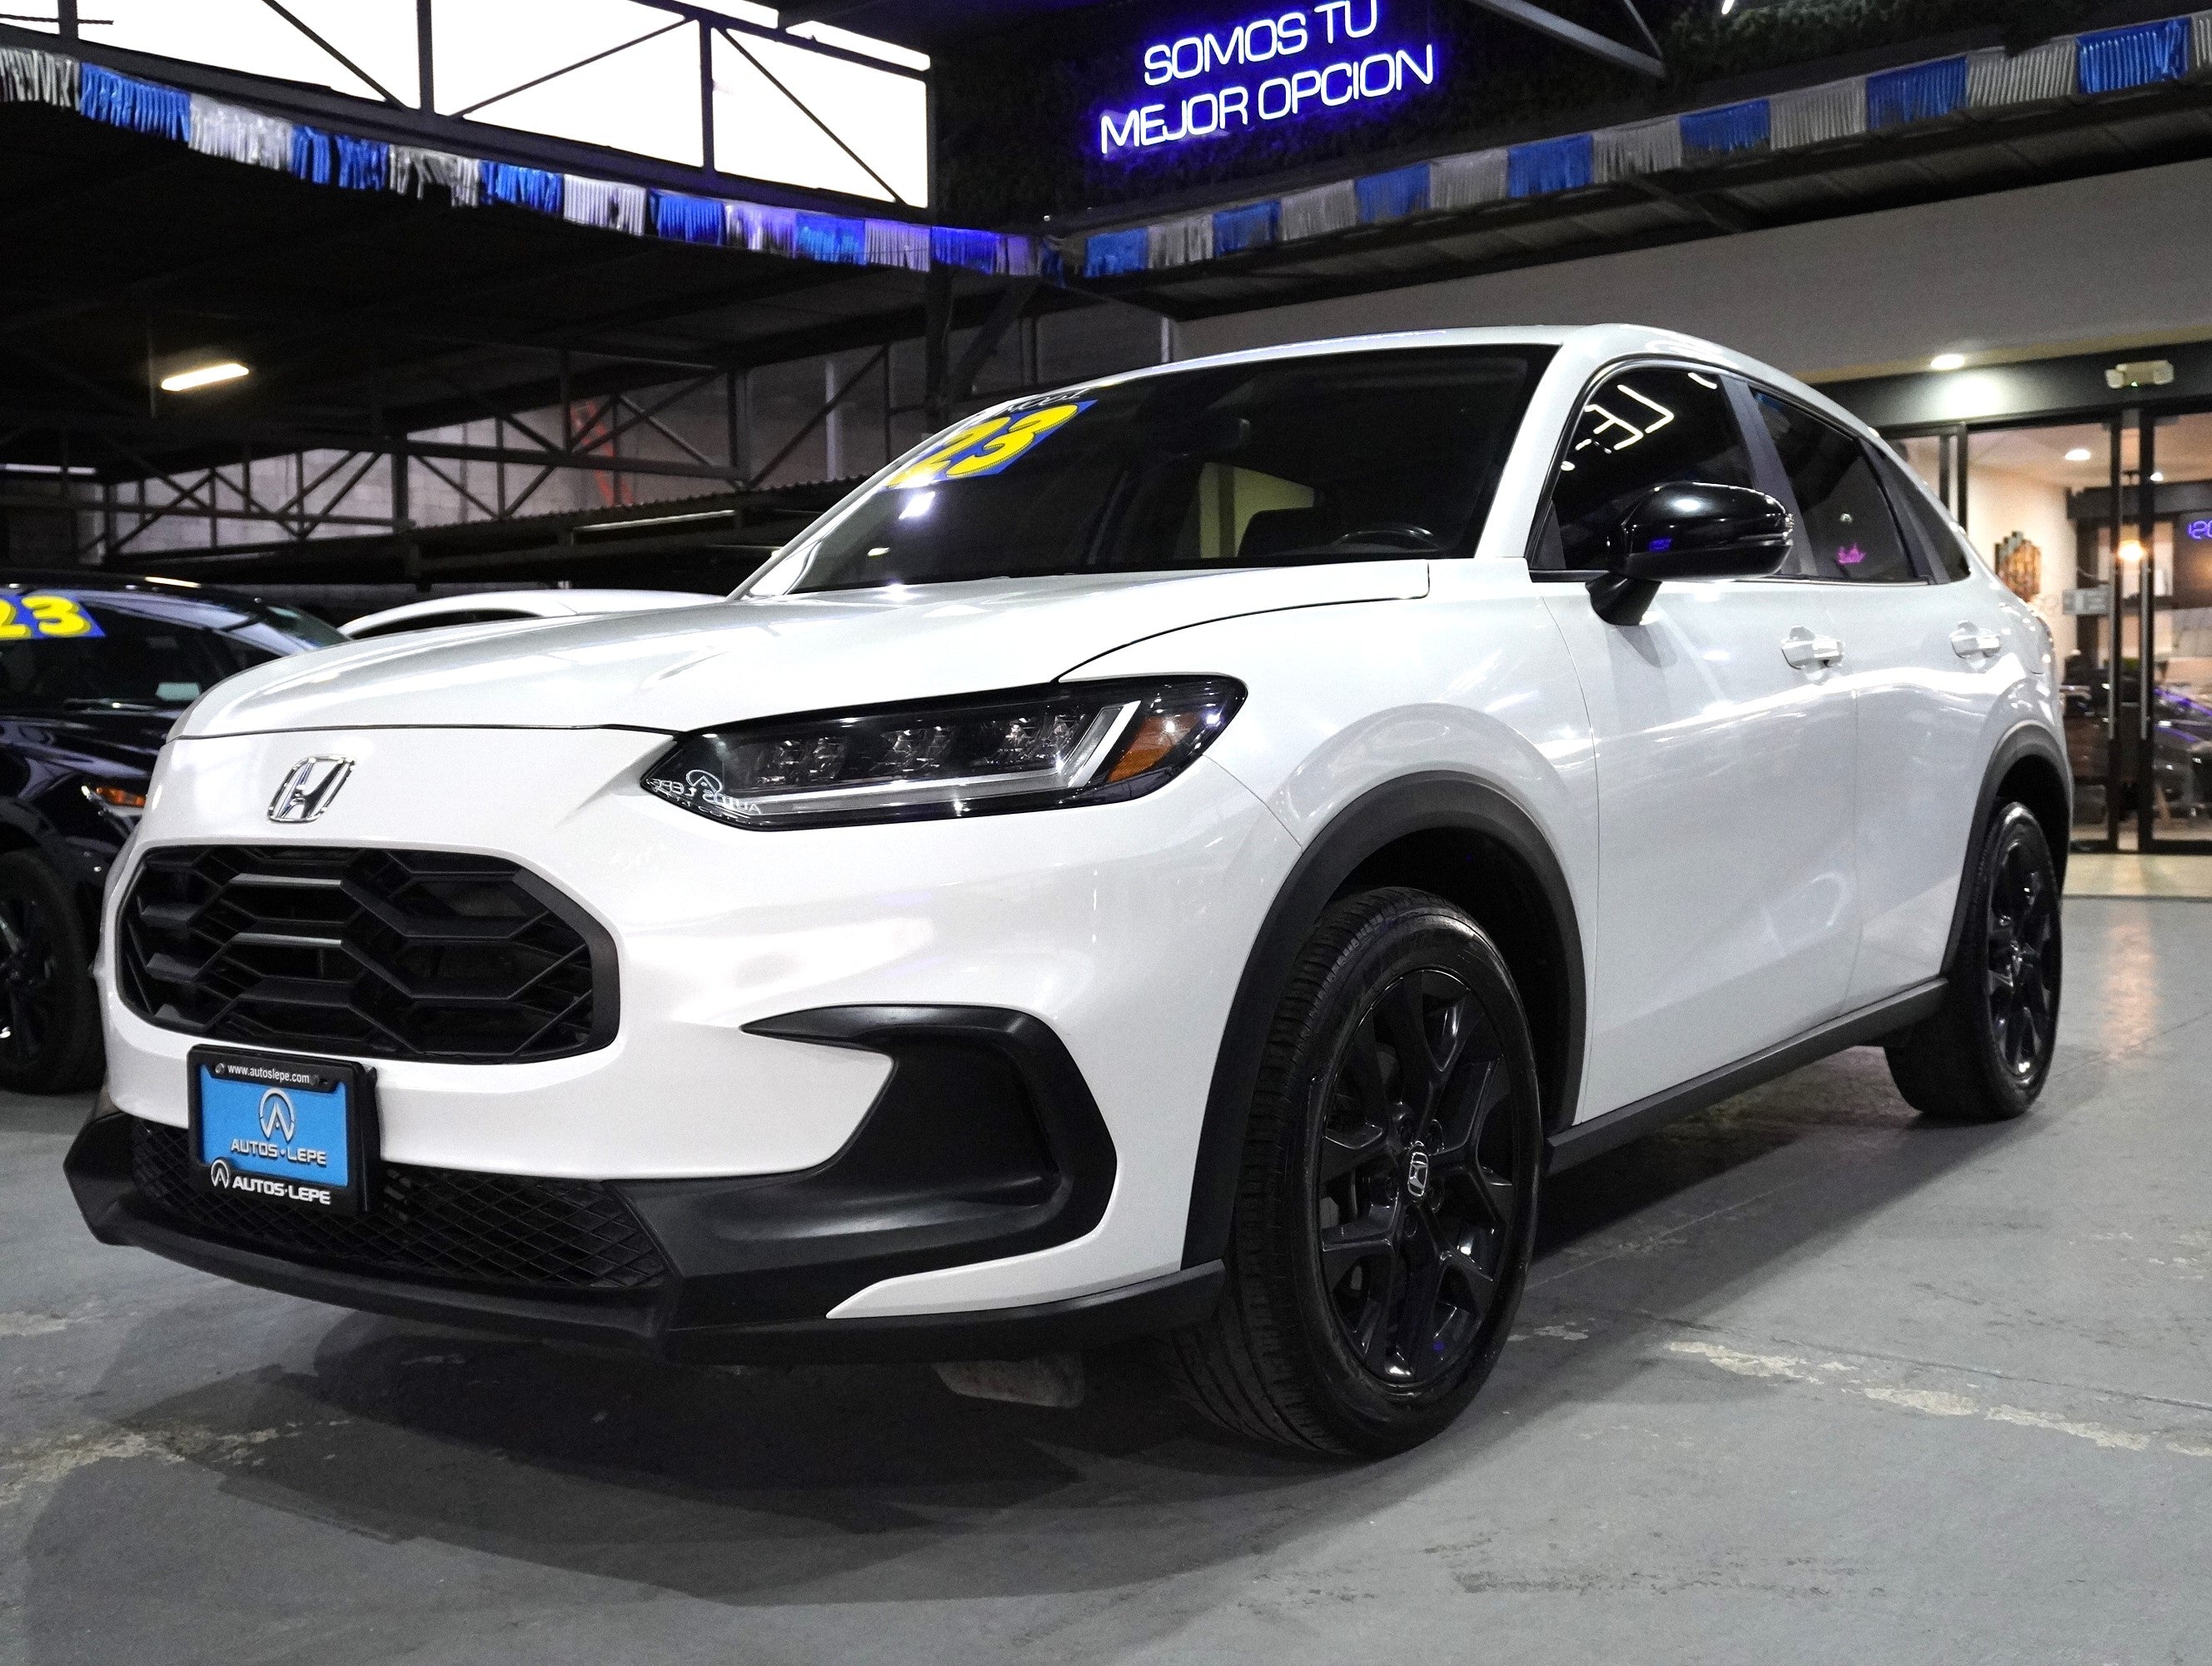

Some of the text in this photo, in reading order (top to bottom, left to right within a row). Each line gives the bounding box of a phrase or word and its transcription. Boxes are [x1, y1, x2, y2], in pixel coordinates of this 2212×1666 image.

[1144, 0, 1378, 86] SOMOS TU
[1100, 44, 1433, 154] MEJOR OPCION
[886, 403, 1079, 488] 23
[227, 1063, 311, 1085] www.autoslepe.com
